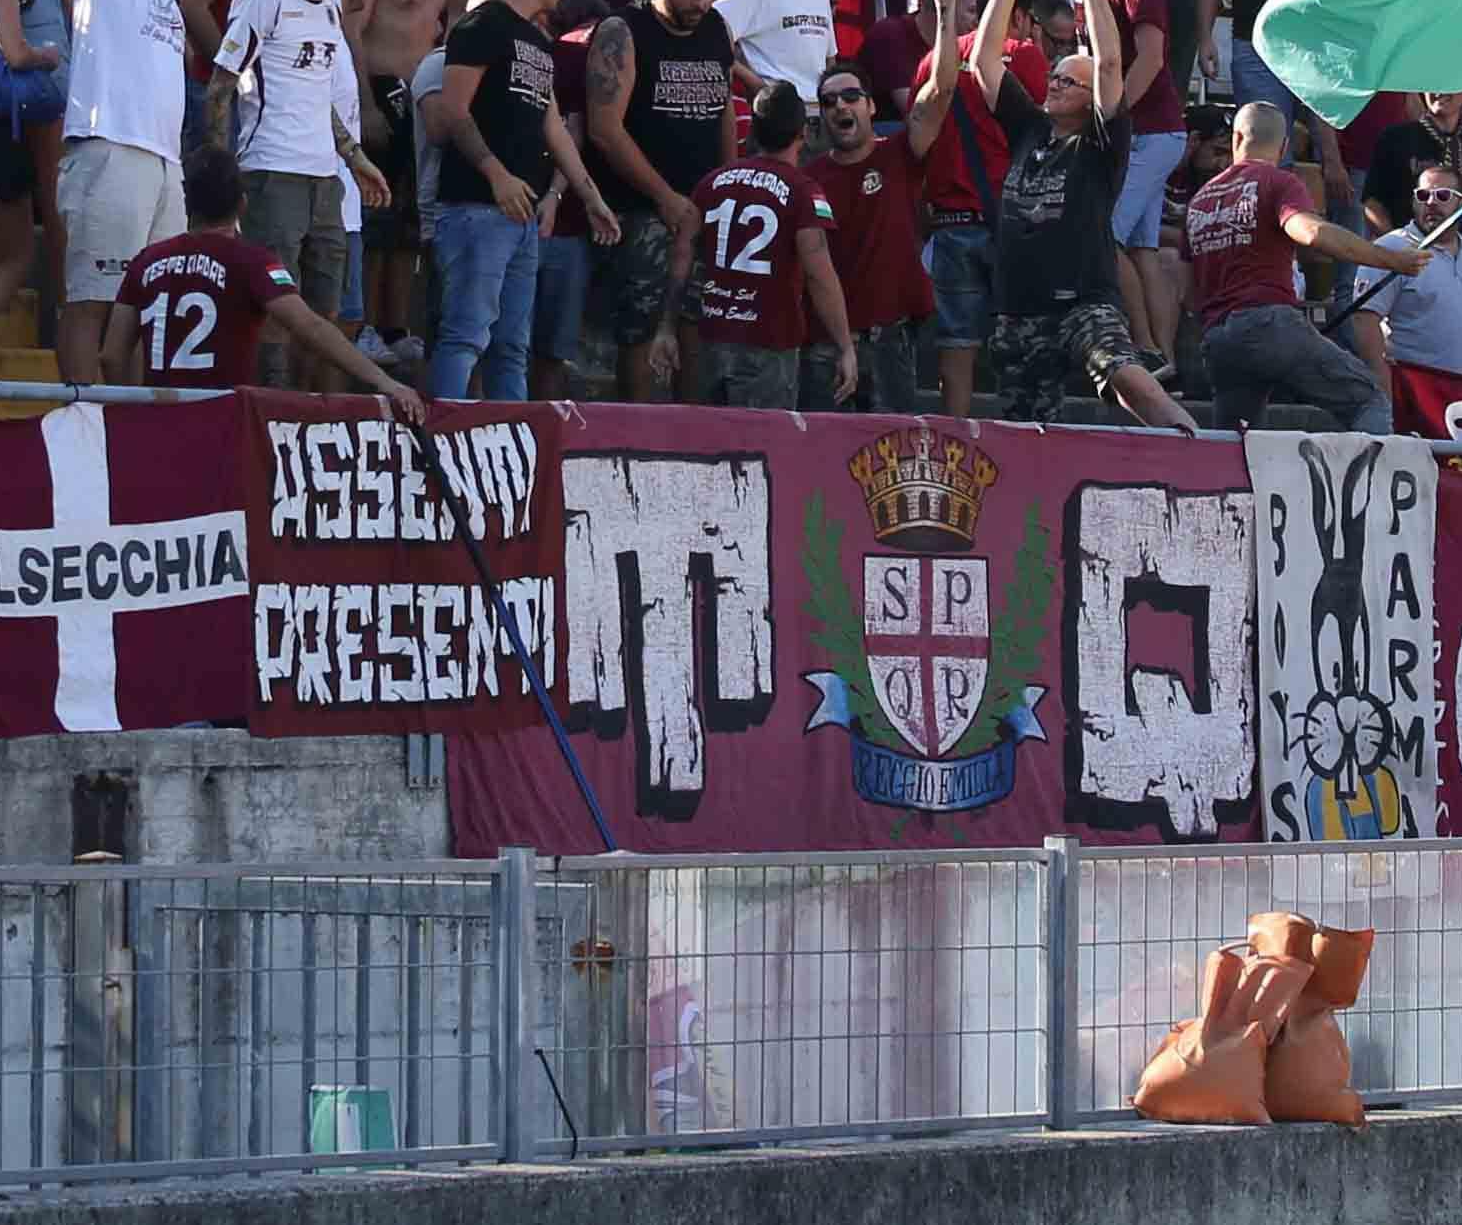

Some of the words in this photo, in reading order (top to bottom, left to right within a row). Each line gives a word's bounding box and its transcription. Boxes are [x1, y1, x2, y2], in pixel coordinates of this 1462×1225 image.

[704, 198, 779, 275] 12
[140, 292, 217, 370] 12
[1386, 469, 1427, 839] PARMA
